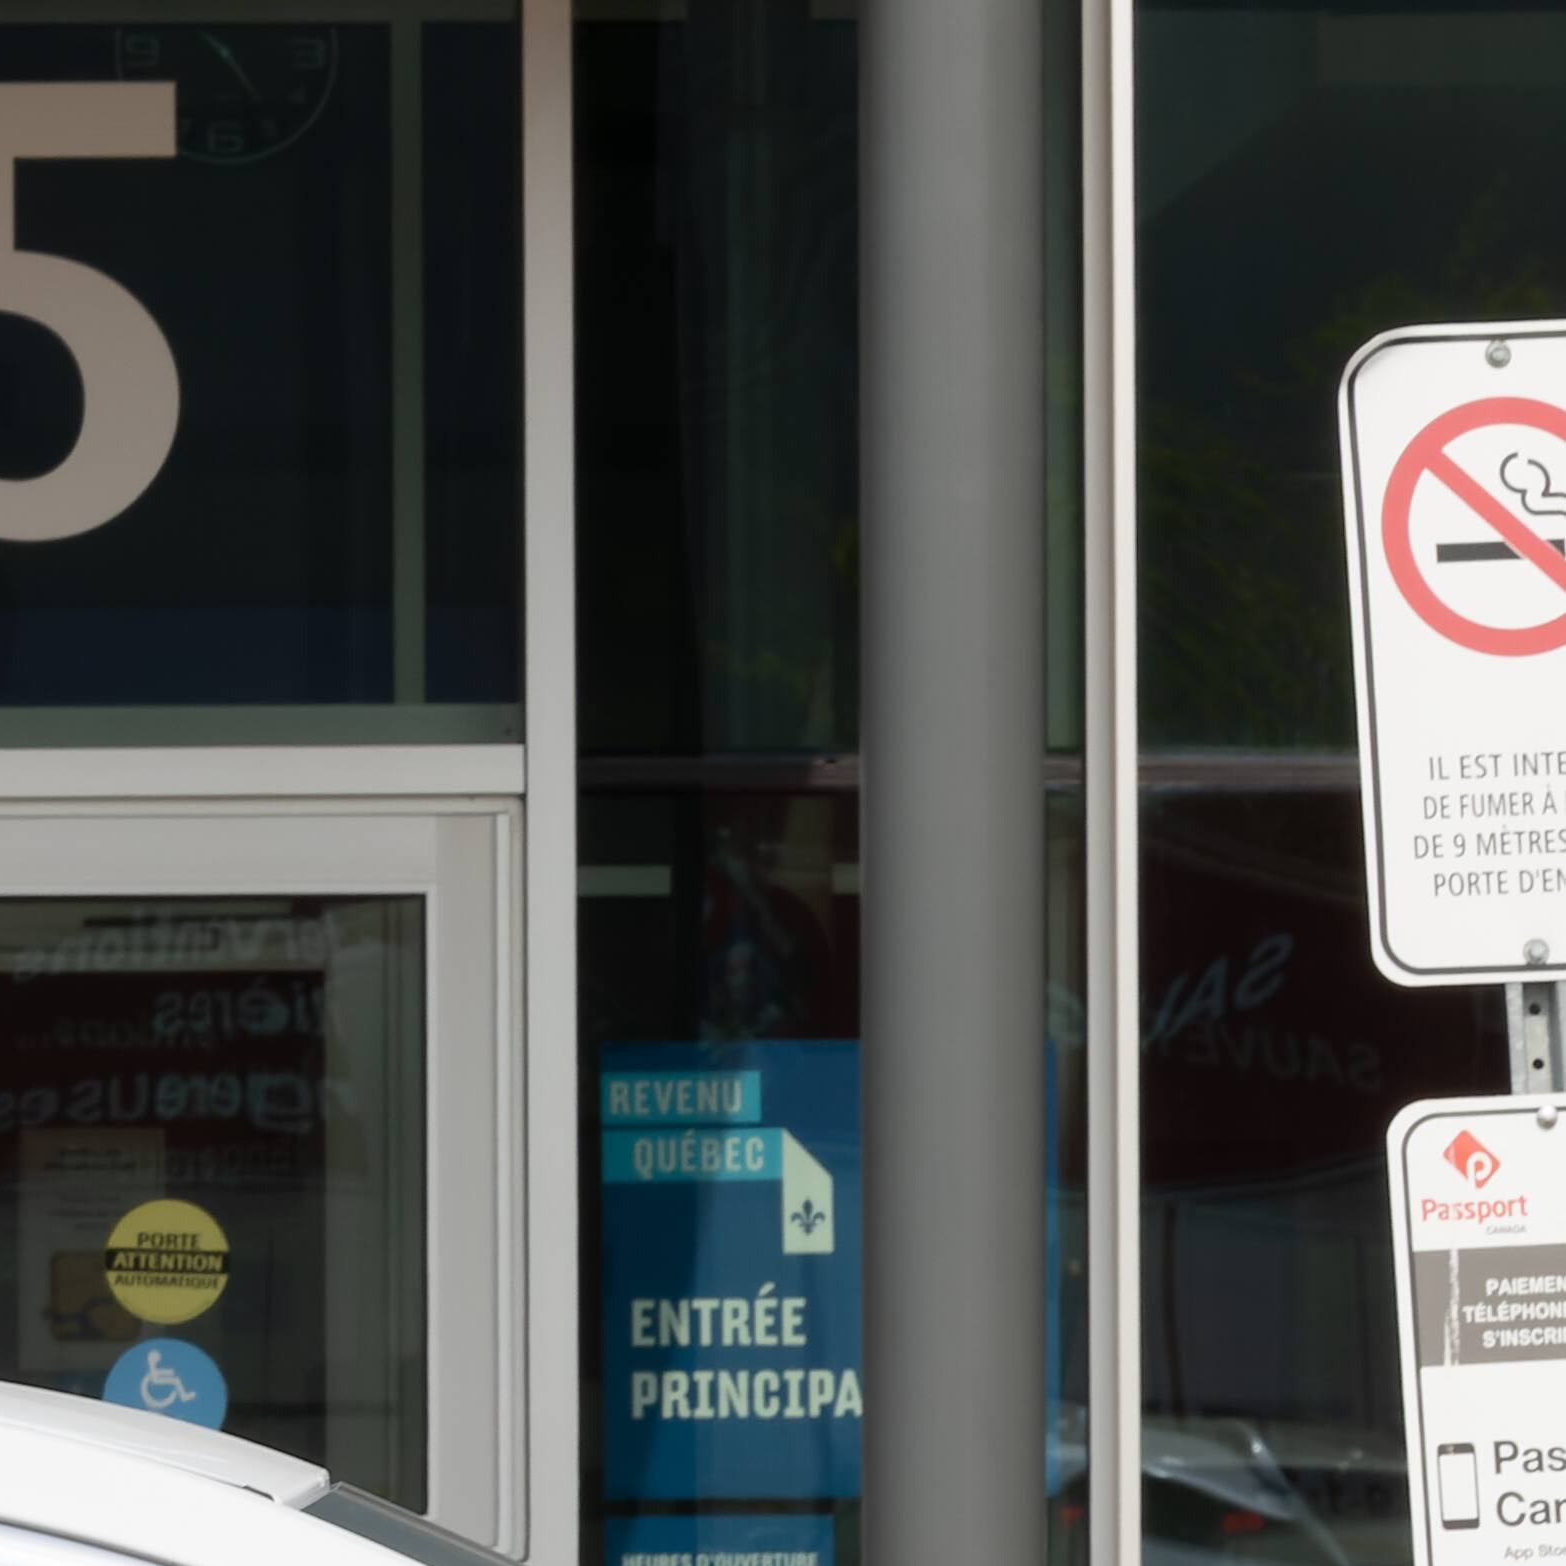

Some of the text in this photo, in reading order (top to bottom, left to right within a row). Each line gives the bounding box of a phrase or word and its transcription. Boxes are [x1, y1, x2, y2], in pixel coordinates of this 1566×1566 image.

[1429, 755, 1451, 781] IL
[1459, 753, 1502, 780] EST
[1423, 782, 1558, 820] DE FUMER À
[1413, 823, 1566, 860] DE 9 MÈTRES
[1433, 869, 1510, 898] PORTE
[609, 1079, 743, 1117] REVENU
[632, 1129, 765, 1180] QUÉBEC
[1420, 1195, 1529, 1224] Passport
[136, 1231, 200, 1250] PORTE
[113, 1250, 224, 1273] ATTENTION
[114, 1274, 220, 1290] AUTOMATIQUE
[630, 1281, 807, 1348] ENTRÉE
[1461, 1299, 1566, 1324] TÉLÉPHON
[630, 1368, 863, 1420] PRINCIPA
[1493, 1440, 1566, 1475] Pas
[1504, 1545, 1534, 1562] App
